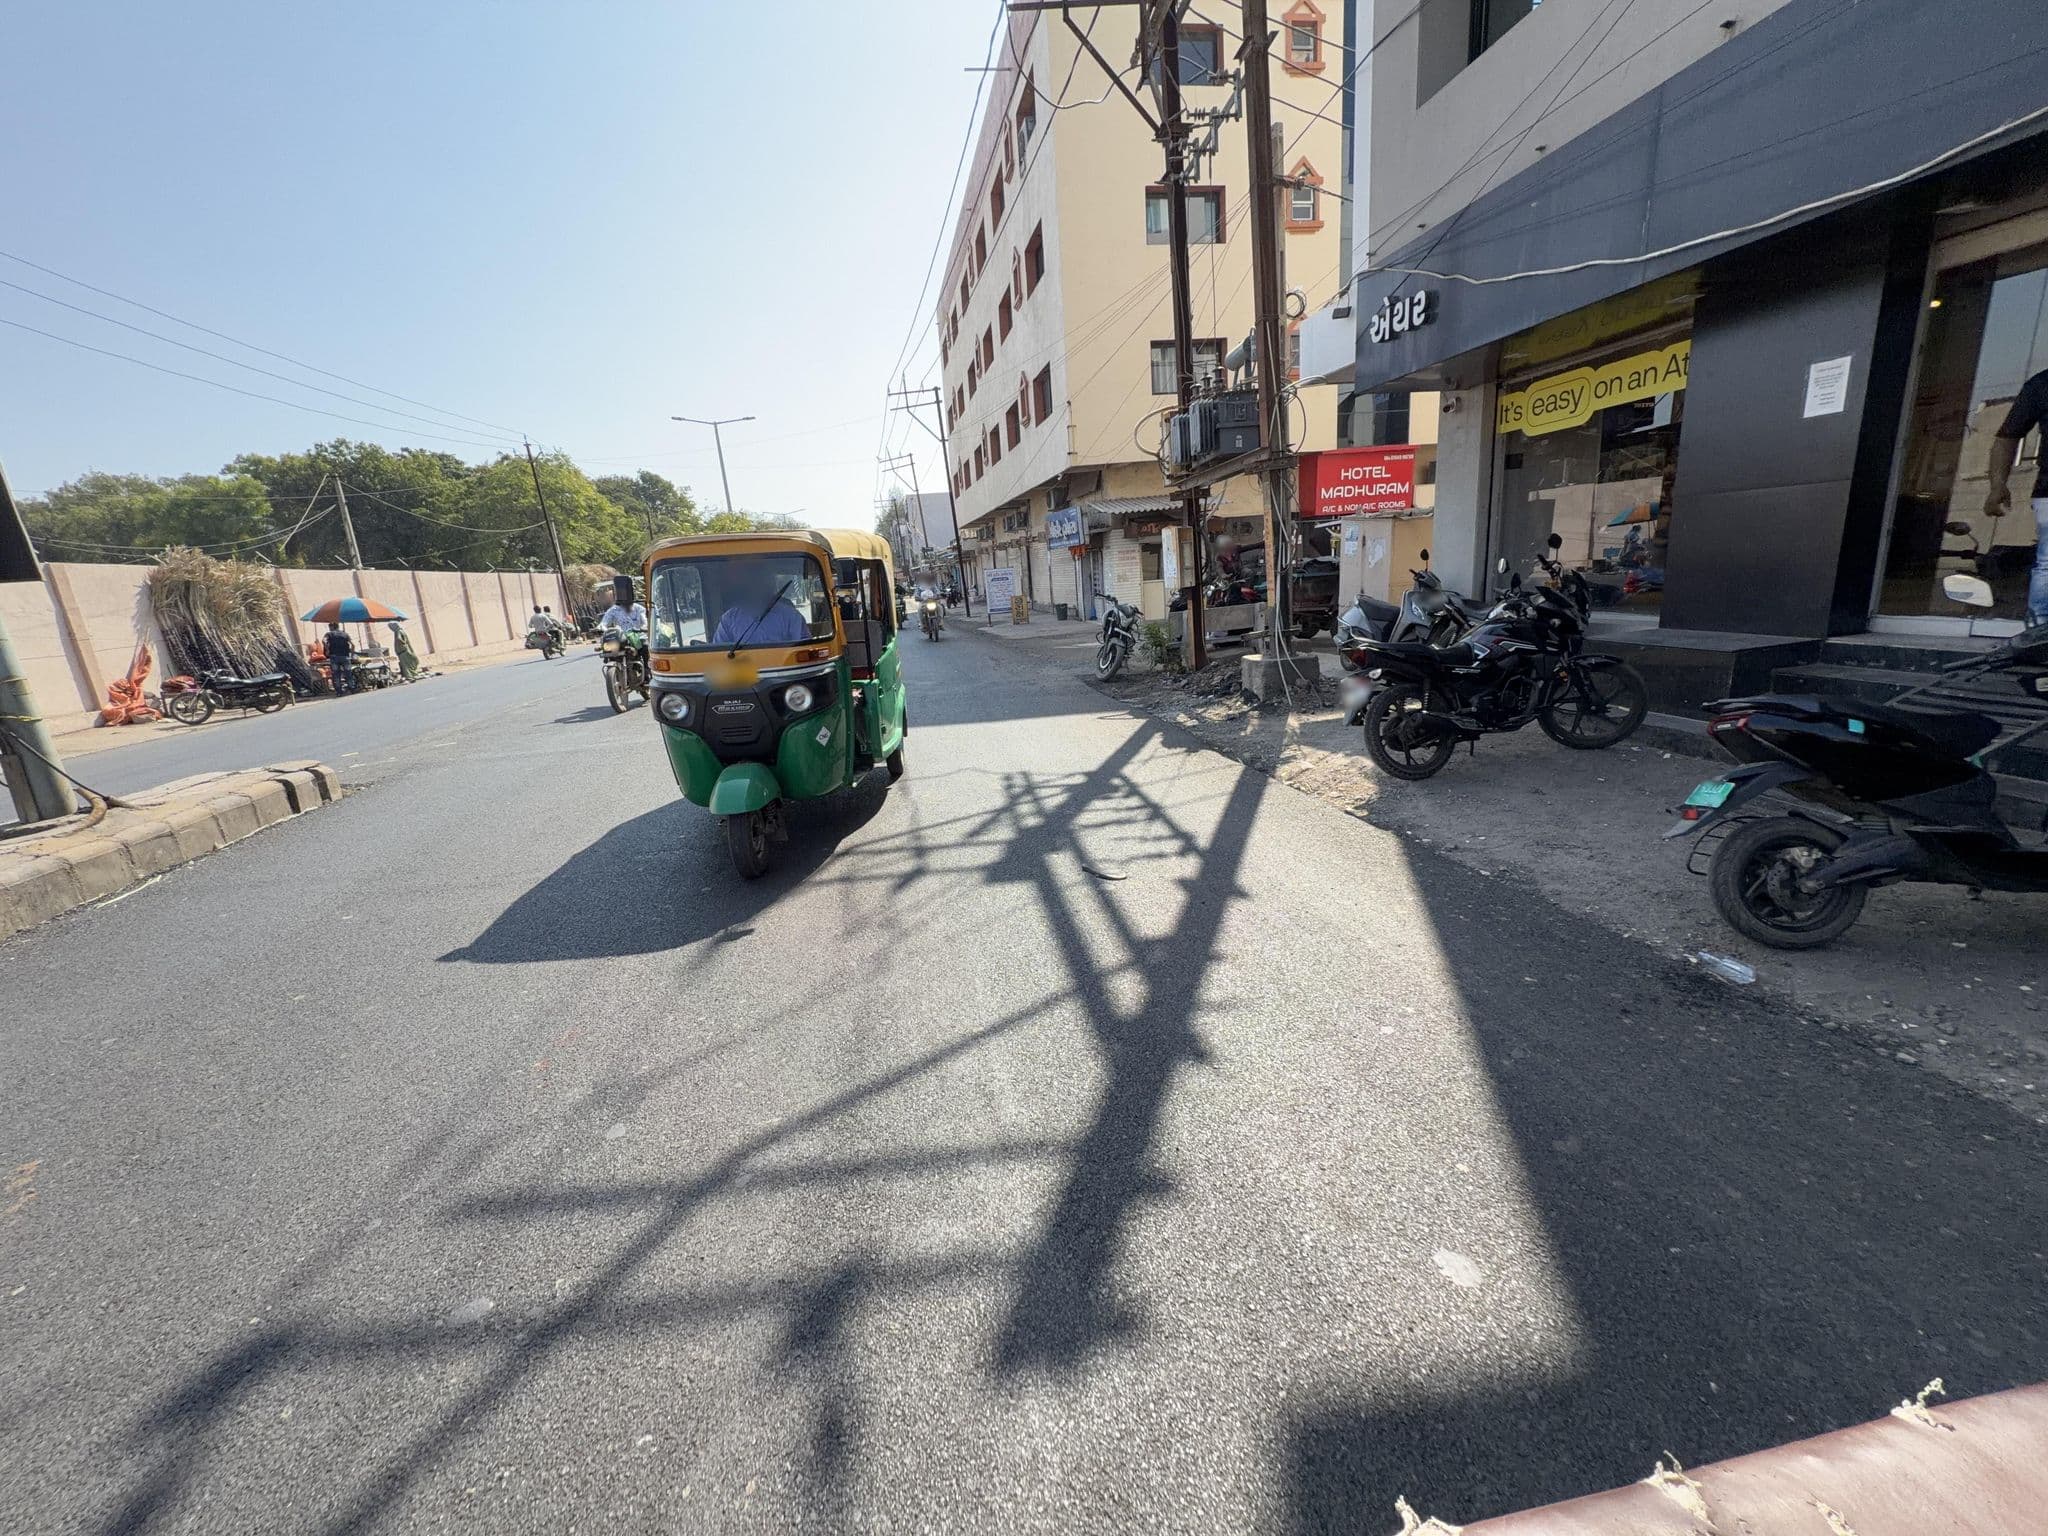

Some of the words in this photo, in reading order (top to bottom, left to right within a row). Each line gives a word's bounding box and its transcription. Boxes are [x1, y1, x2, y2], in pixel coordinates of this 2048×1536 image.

[1370, 290, 1426, 344] એથર
[1500, 402, 1523, 426] It's
[1531, 385, 1584, 416] easy
[1594, 376, 1623, 399] on
[1627, 366, 1658, 390] an
[1341, 465, 1391, 480] HOTEL
[1321, 482, 1409, 499] MADHURAM
[1377, 500, 1406, 509] ROOMS
